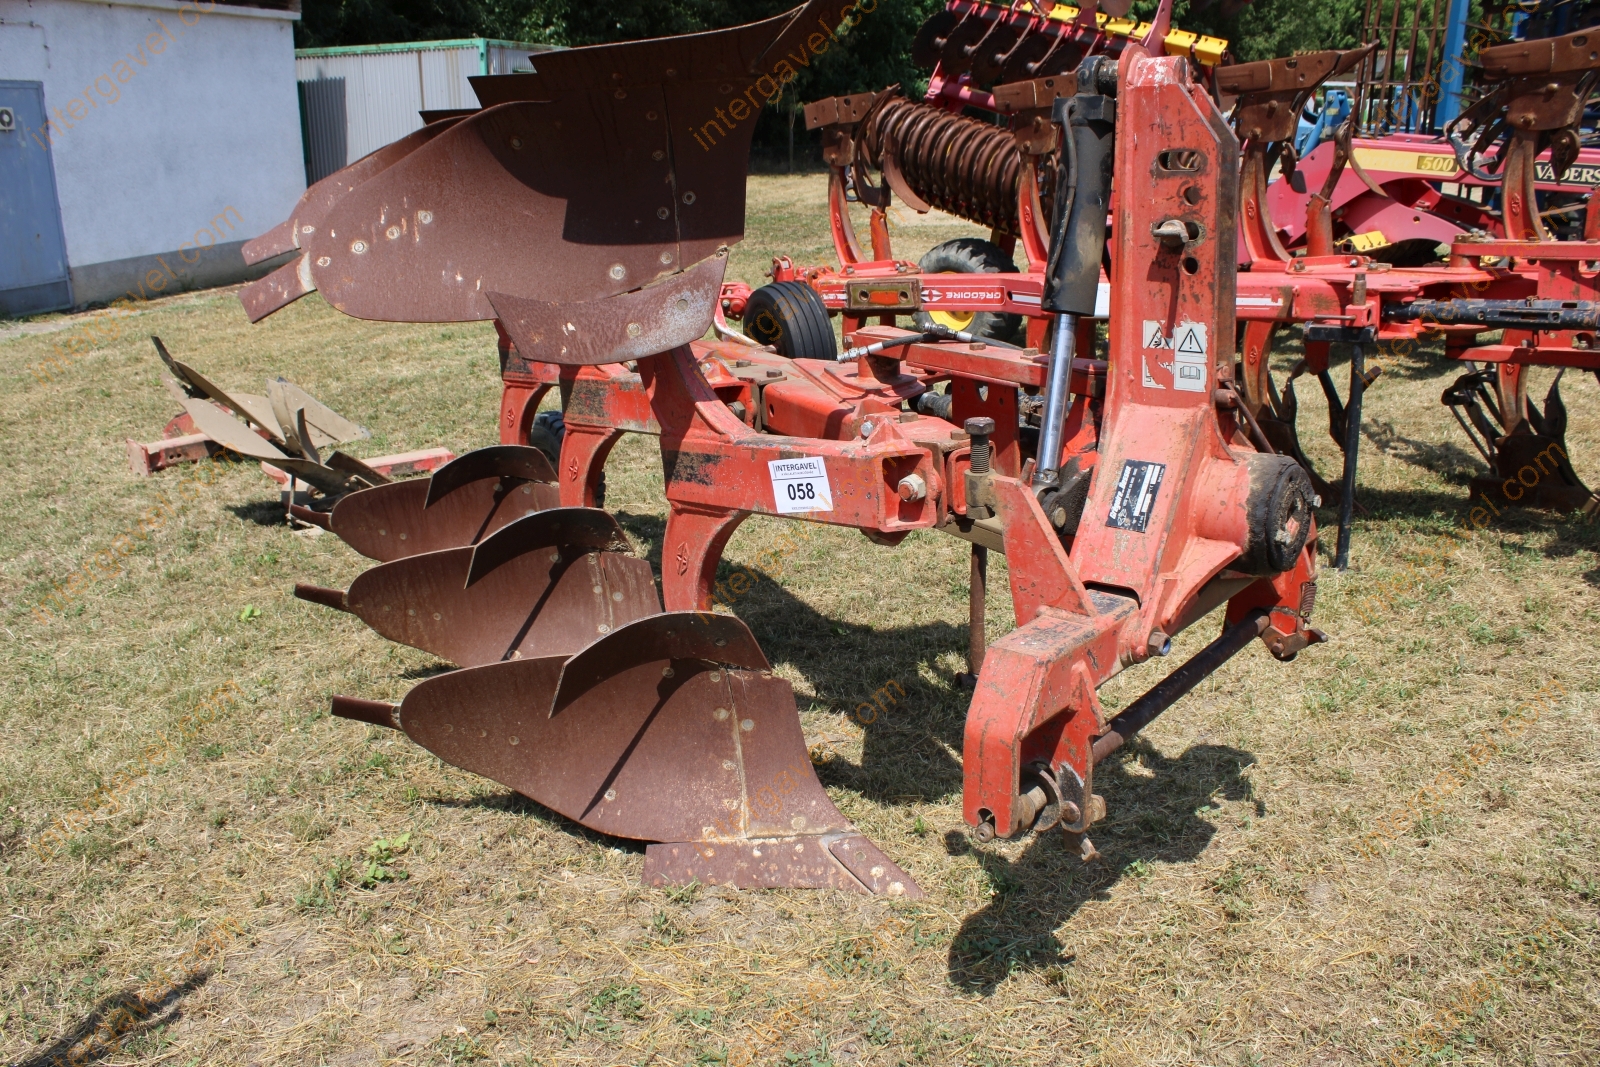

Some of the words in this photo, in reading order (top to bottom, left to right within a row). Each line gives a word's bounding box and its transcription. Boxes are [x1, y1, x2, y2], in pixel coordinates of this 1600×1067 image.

[1422, 157, 1454, 172] 500
[945, 291, 1002, 300] GRÉGOIRE
[775, 462, 817, 472] INTERGAVEL
[787, 482, 815, 501] 058
